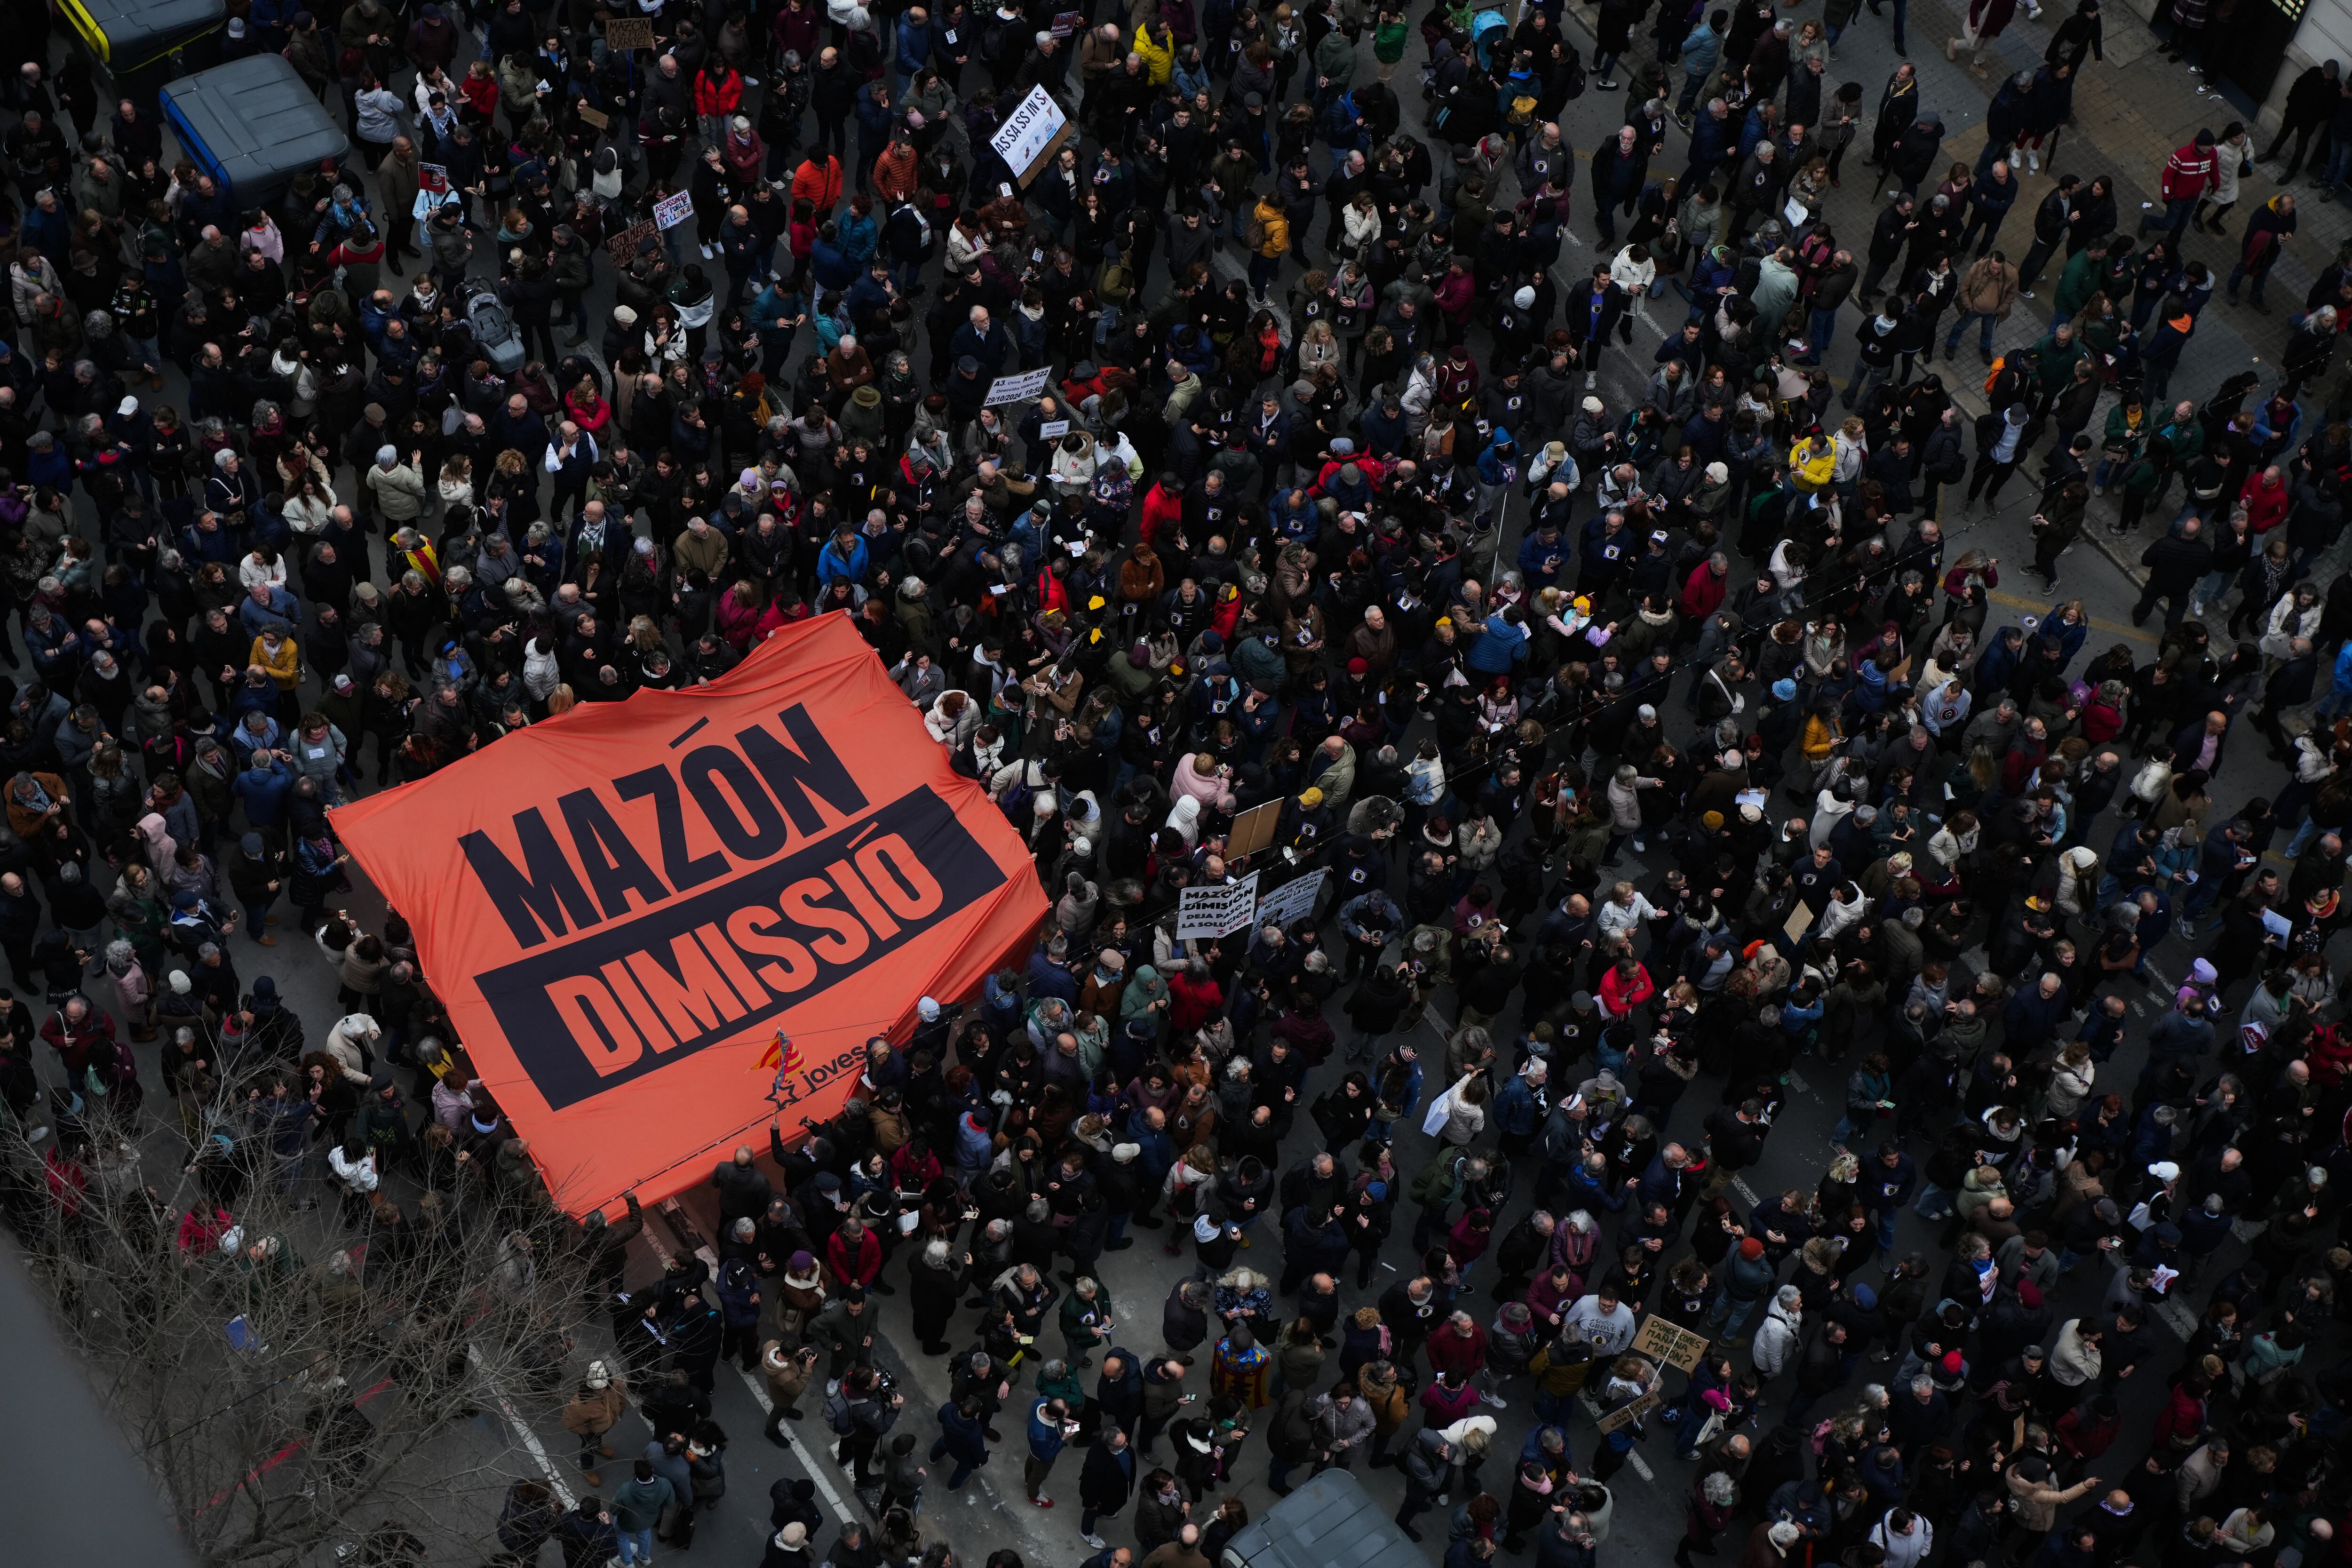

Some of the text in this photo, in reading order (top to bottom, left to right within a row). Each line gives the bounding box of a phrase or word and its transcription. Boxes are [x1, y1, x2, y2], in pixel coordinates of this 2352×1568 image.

[609, 19, 651, 33] MAZÓN
[1035, 370, 1049, 379] 322
[986, 386, 1042, 405] 29/10/2024 19:50
[457, 702, 870, 950] MAZÓN
[1303, 883, 1318, 893] CARA
[1184, 886, 1254, 912] DIMISIÓN
[1186, 912, 1214, 920] DEJA
[1216, 904, 1243, 920] PASO
[1197, 906, 1252, 929] SOLUCIÓN
[1229, 915, 1250, 931] UCE
[543, 821, 943, 1078] DIMISSIÓ
[48, 987, 79, 998] WHITNEY
[1589, 1321, 1616, 1333] GROVE
[1651, 1321, 1702, 1350] DONDE COMES
